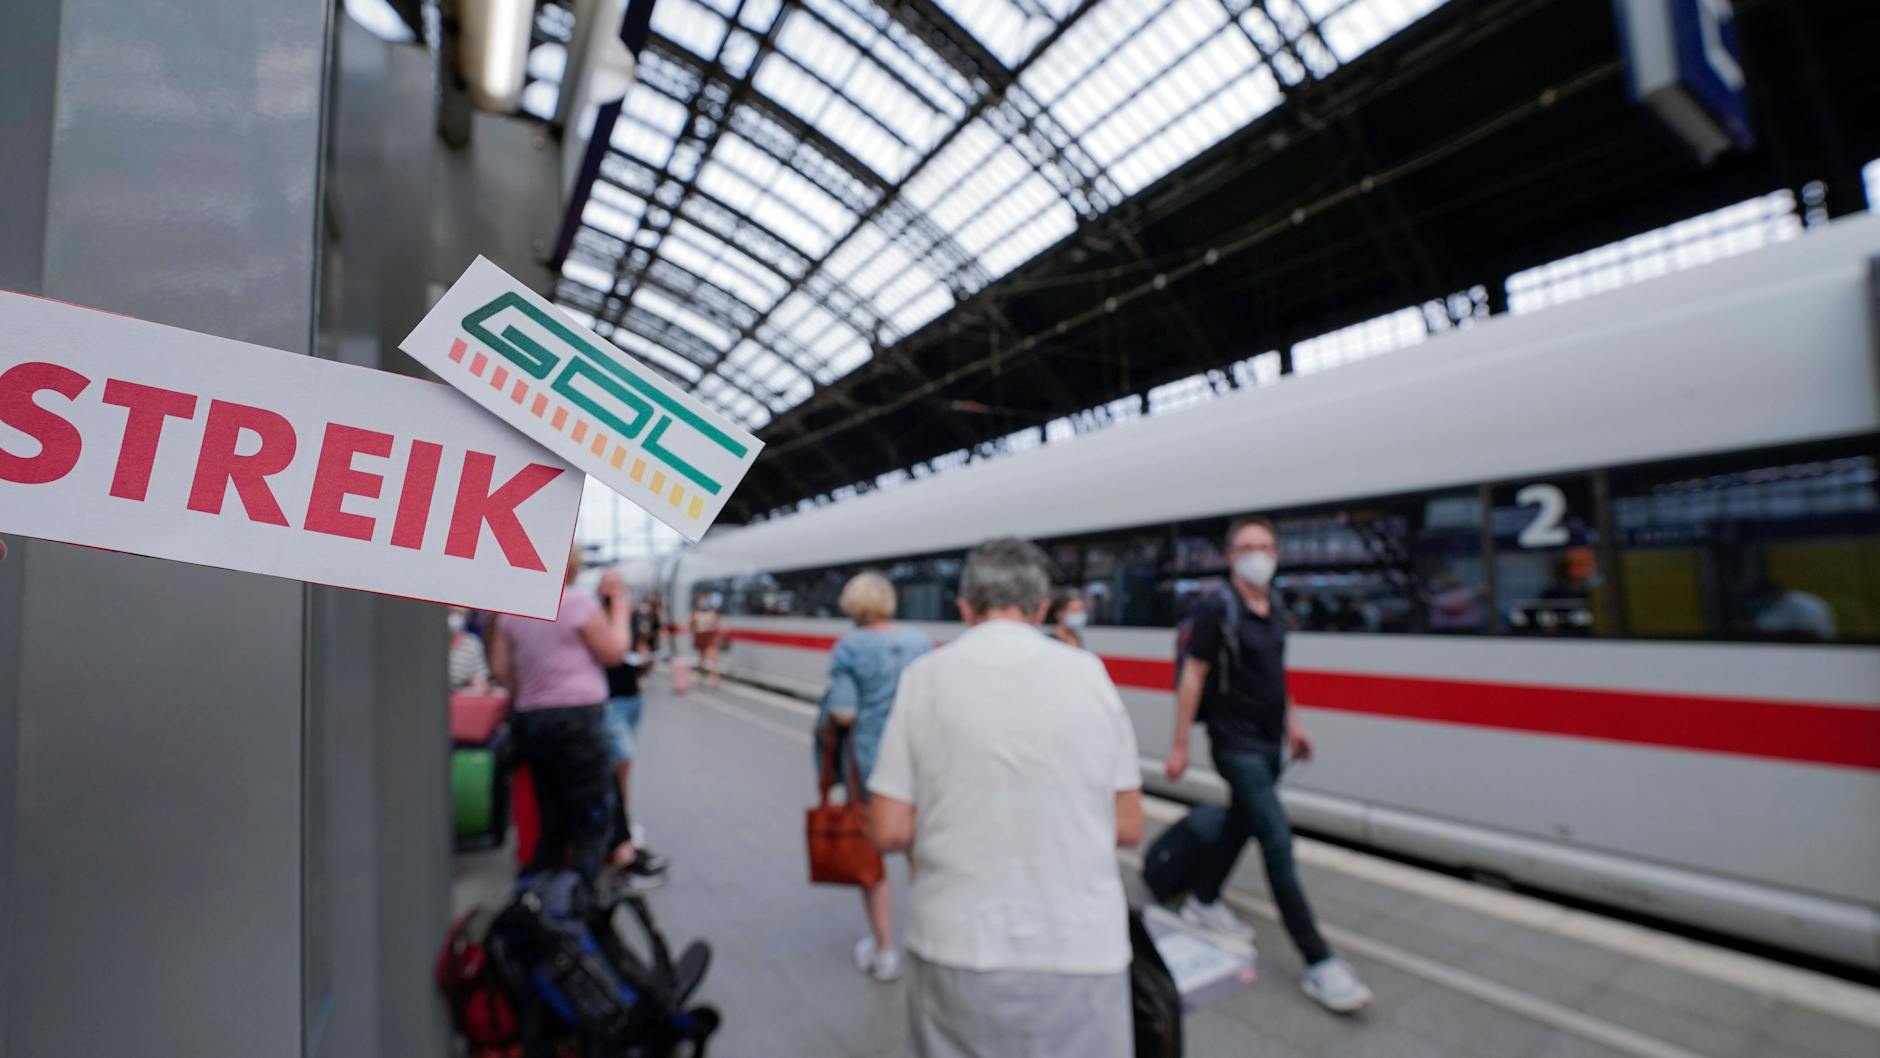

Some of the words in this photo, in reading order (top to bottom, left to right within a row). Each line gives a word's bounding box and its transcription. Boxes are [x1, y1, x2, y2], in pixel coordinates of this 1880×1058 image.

[0, 361, 565, 572] STREIK
[461, 291, 748, 495] GDL
[1515, 484, 1570, 548] 2
